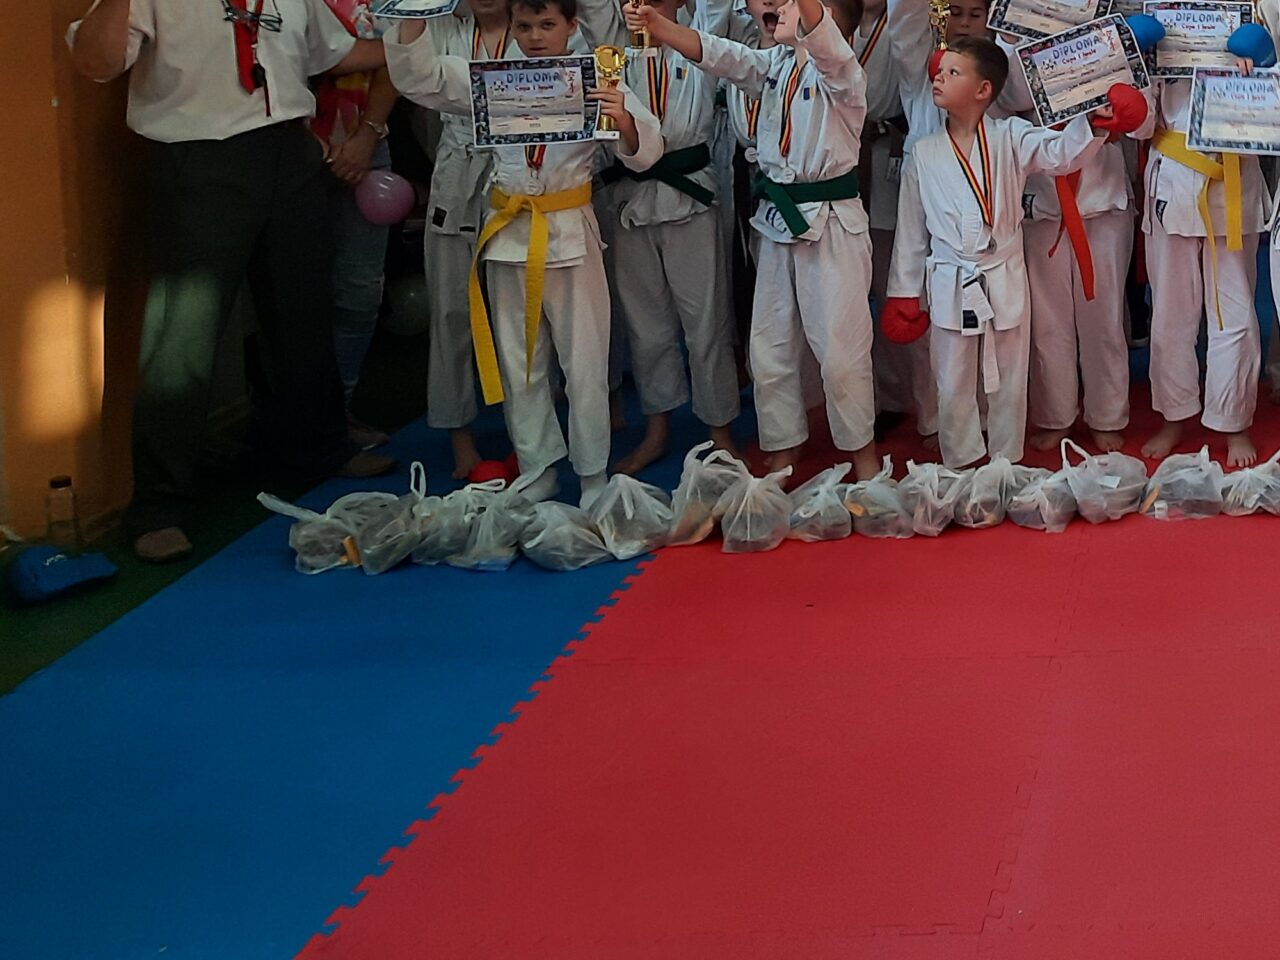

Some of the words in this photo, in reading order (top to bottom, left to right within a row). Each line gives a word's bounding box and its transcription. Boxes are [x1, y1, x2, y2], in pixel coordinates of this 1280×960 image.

[1175, 12, 1222, 22] DIPLOMA
[1052, 35, 1100, 60] DIPLOMA
[506, 72, 560, 83] DIPLOMA
